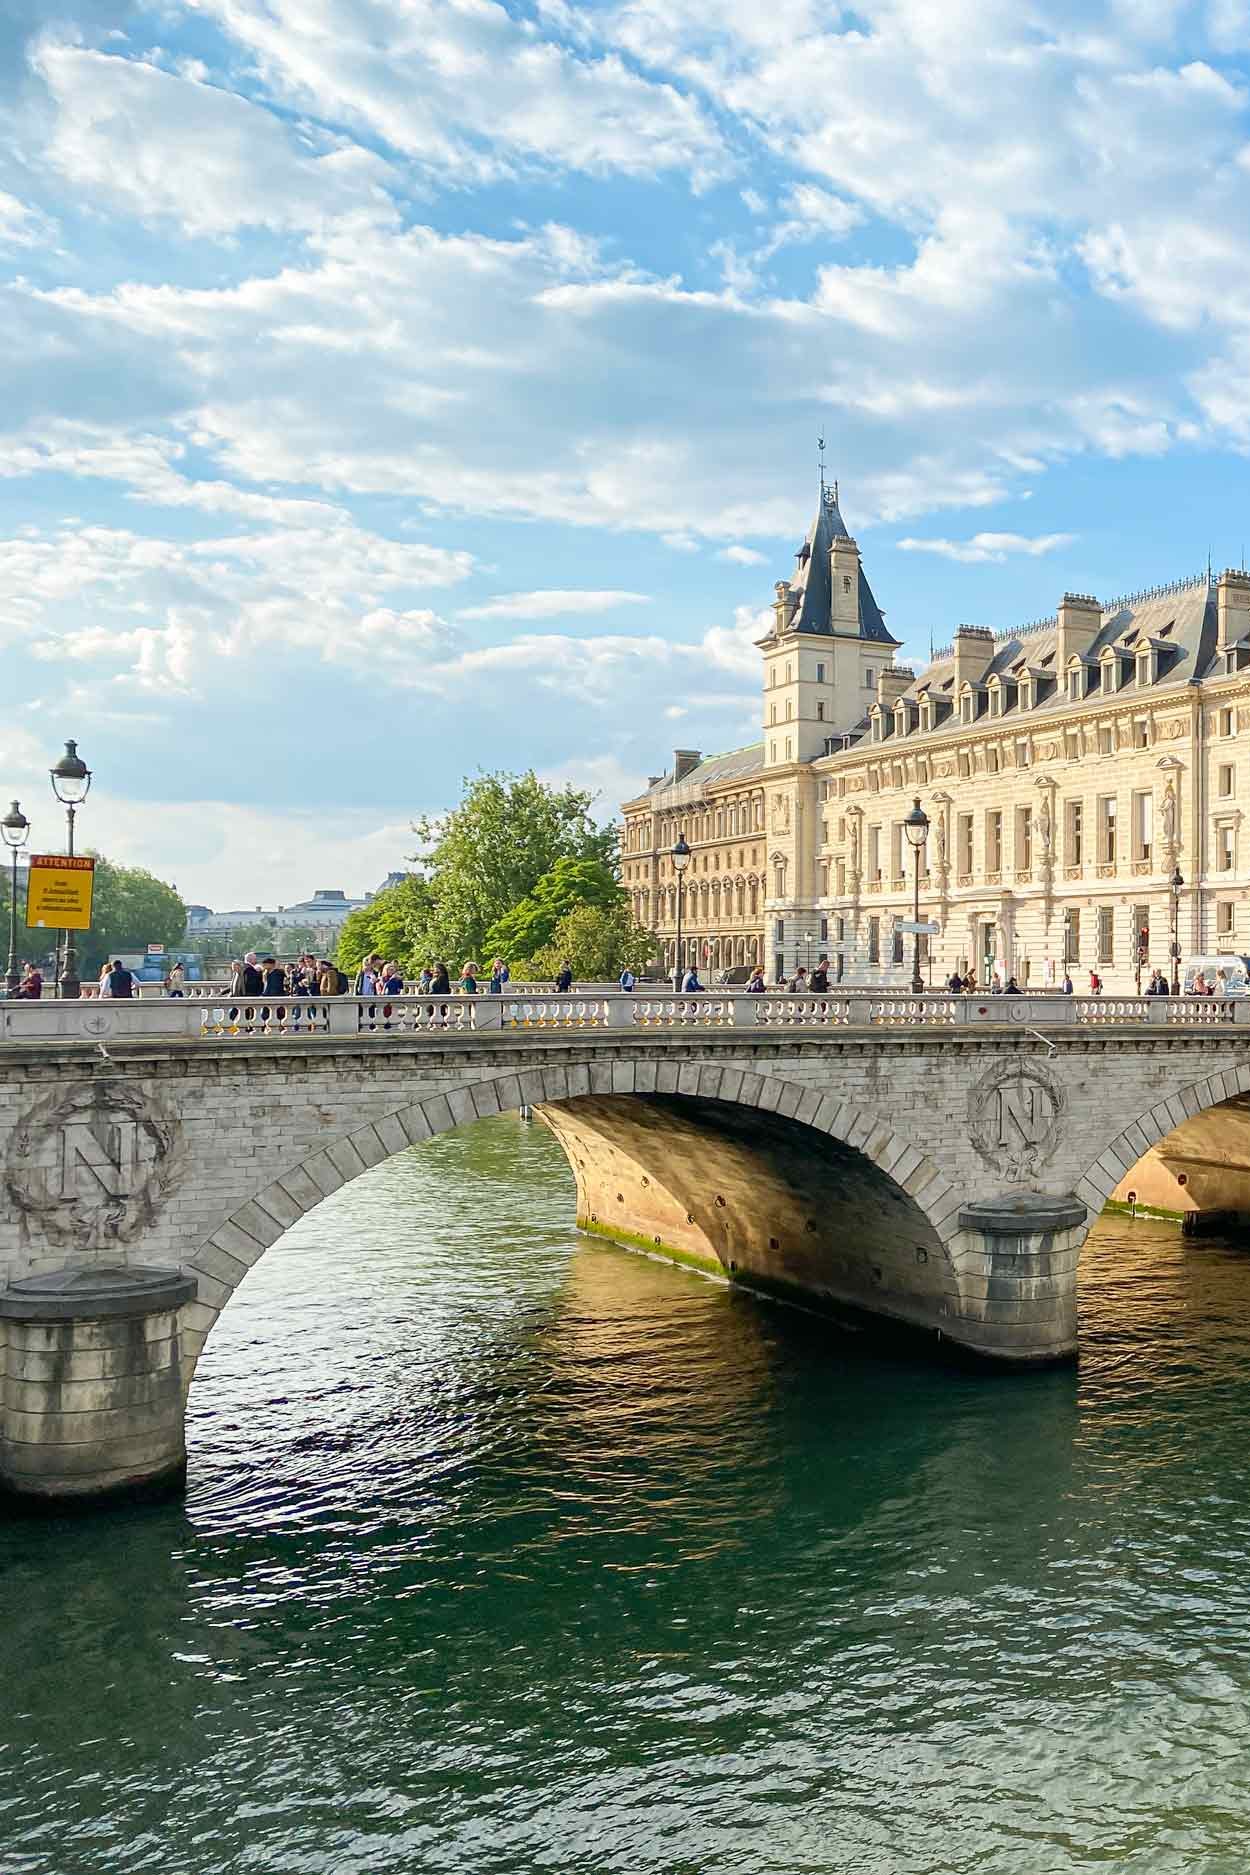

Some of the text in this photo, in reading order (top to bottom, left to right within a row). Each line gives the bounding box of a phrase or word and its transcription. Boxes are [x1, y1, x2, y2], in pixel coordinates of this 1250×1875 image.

[36, 857, 91, 868] ATTENTION
[996, 1086, 1044, 1148] N
[57, 1122, 138, 1203] N
